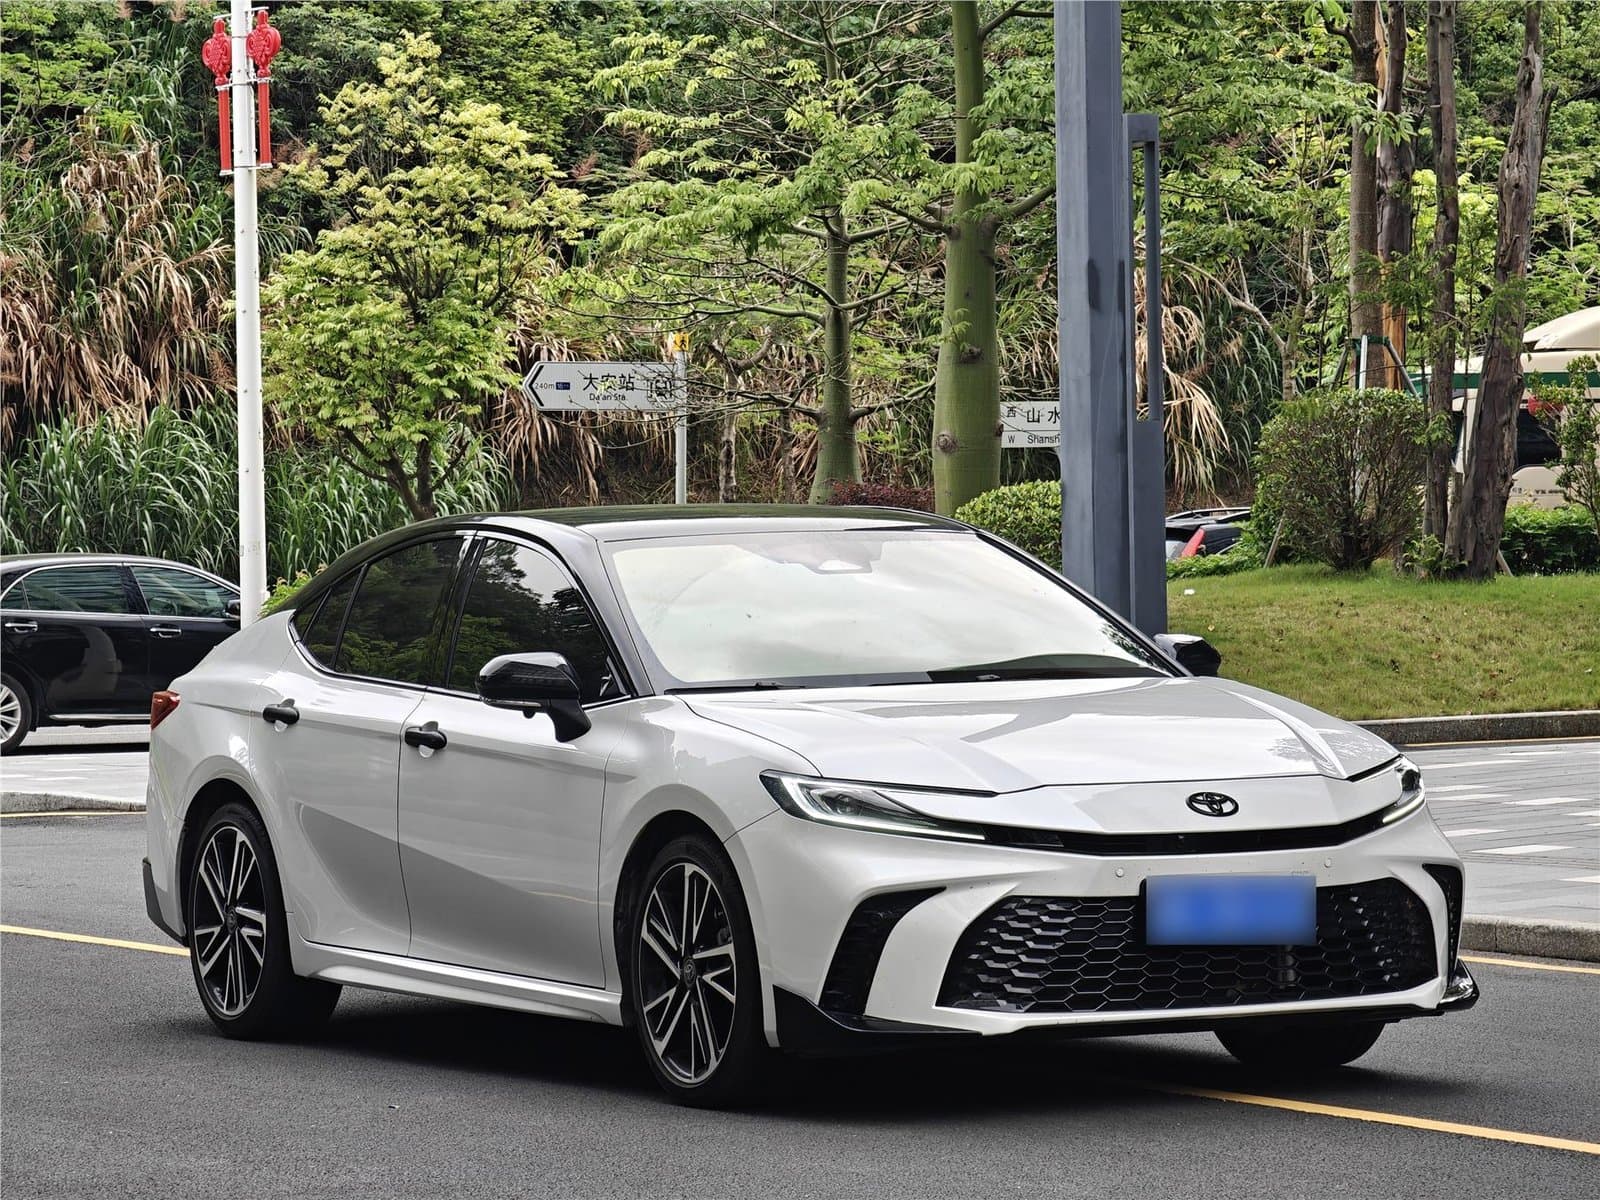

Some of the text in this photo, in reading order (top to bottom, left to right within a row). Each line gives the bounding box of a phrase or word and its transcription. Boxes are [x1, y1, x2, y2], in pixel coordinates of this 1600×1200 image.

[583, 373, 635, 391] 大安站
[1026, 406, 1060, 424] 山水
[1007, 435, 1016, 443] W
